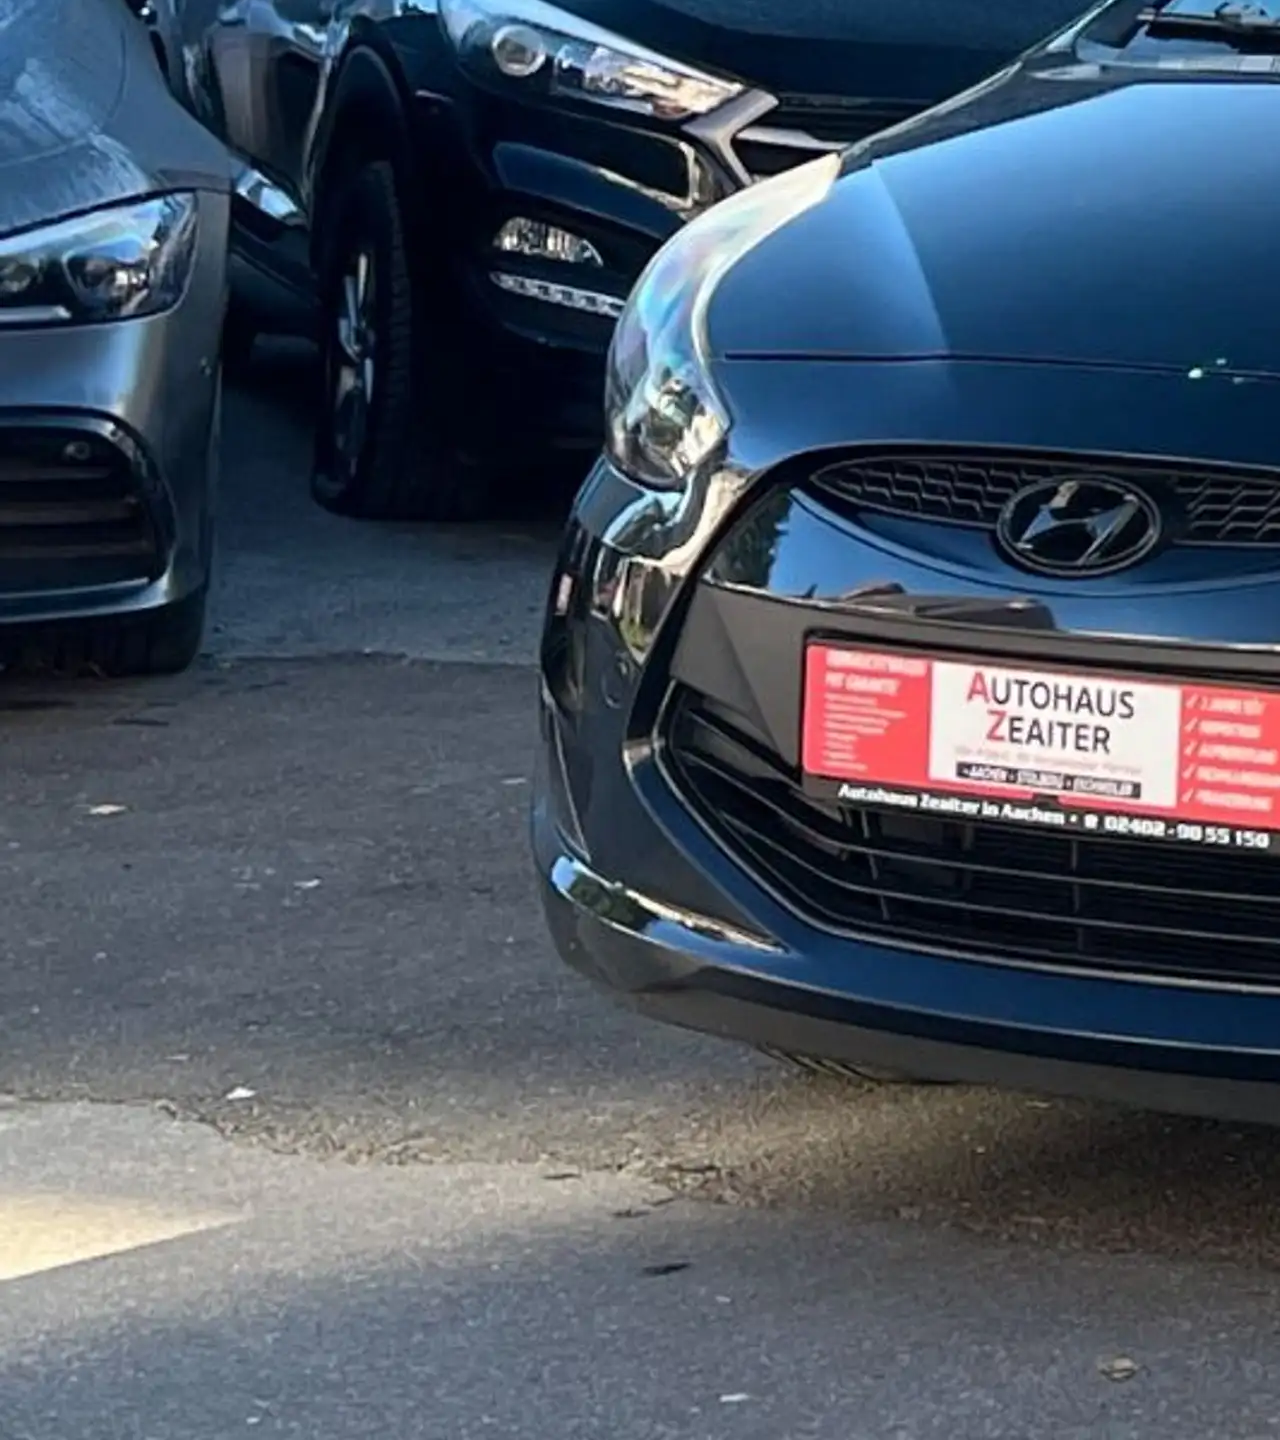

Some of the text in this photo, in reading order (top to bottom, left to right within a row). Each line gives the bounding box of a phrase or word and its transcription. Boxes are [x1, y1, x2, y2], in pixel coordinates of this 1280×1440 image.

[967, 671, 1134, 720] AUTOHAUS
[985, 709, 1111, 756] ZEAITER
[838, 783, 918, 808] Autohaus
[920, 792, 980, 815] Zeaiter
[1000, 802, 1065, 826] Aachen
